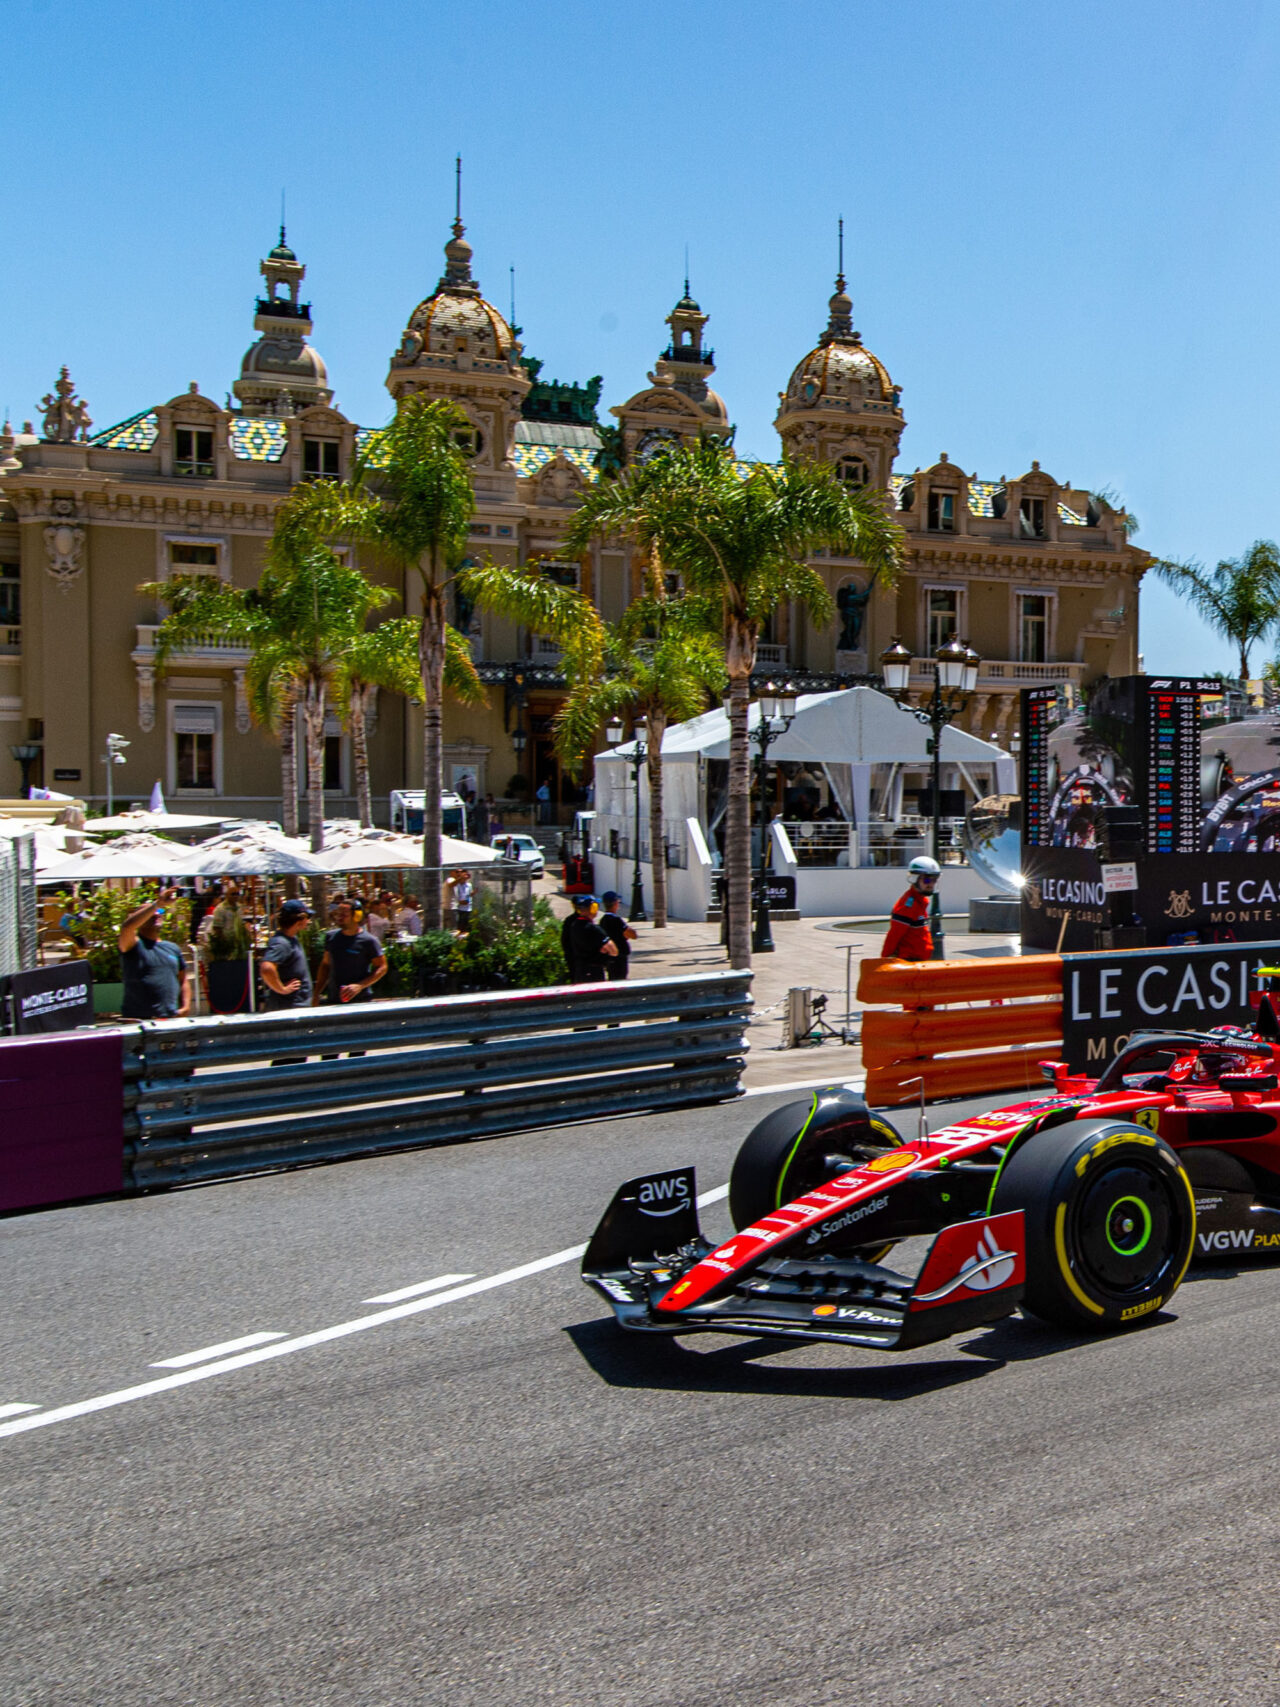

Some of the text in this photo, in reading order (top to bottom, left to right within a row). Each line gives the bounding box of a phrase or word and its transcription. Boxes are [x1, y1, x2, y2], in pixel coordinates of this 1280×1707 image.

[1180, 681, 1191, 689] P1
[1238, 773, 1273, 791] ORACLE
[1206, 794, 1234, 822] BYBIT
[1042, 878, 1107, 906] LE CASINO
[1201, 881, 1231, 905] LE
[1071, 968, 1121, 1021] LE
[638, 1176, 689, 1204] aws
[821, 1195, 890, 1237] Santander
[1198, 1229, 1255, 1251] VGW
[838, 1308, 903, 1325] V-Pow
